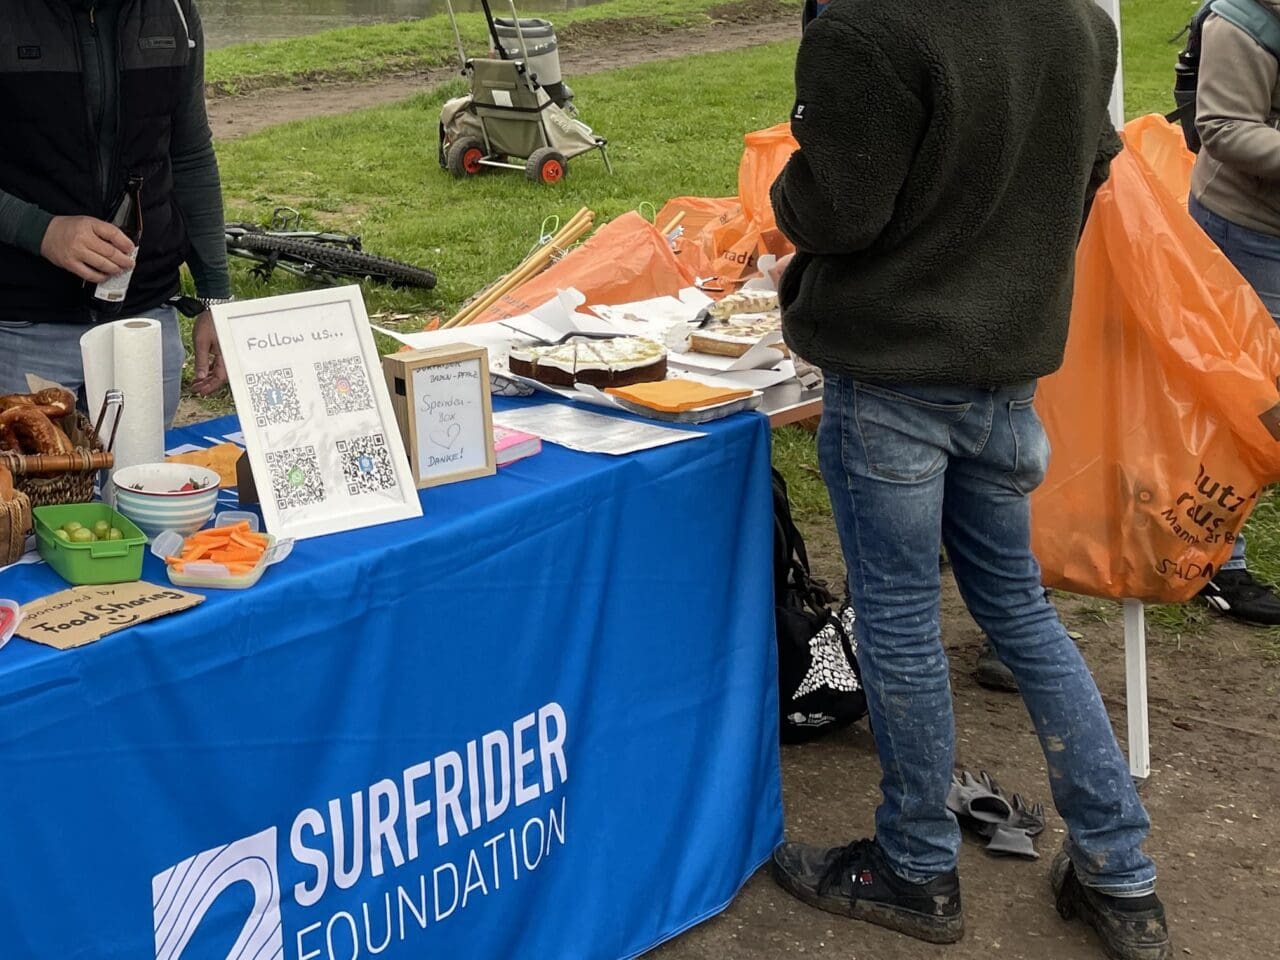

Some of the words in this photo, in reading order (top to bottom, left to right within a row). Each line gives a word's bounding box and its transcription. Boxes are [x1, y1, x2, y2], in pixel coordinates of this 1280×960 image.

[246, 332, 305, 351] Follow
[428, 447, 464, 468] DANKE!
[1194, 463, 1246, 512] utz
[30, 610, 100, 634] Food
[95, 591, 185, 616] Sharing
[290, 701, 568, 907] SURFRIDER
[297, 796, 566, 960] FOUNDATION
